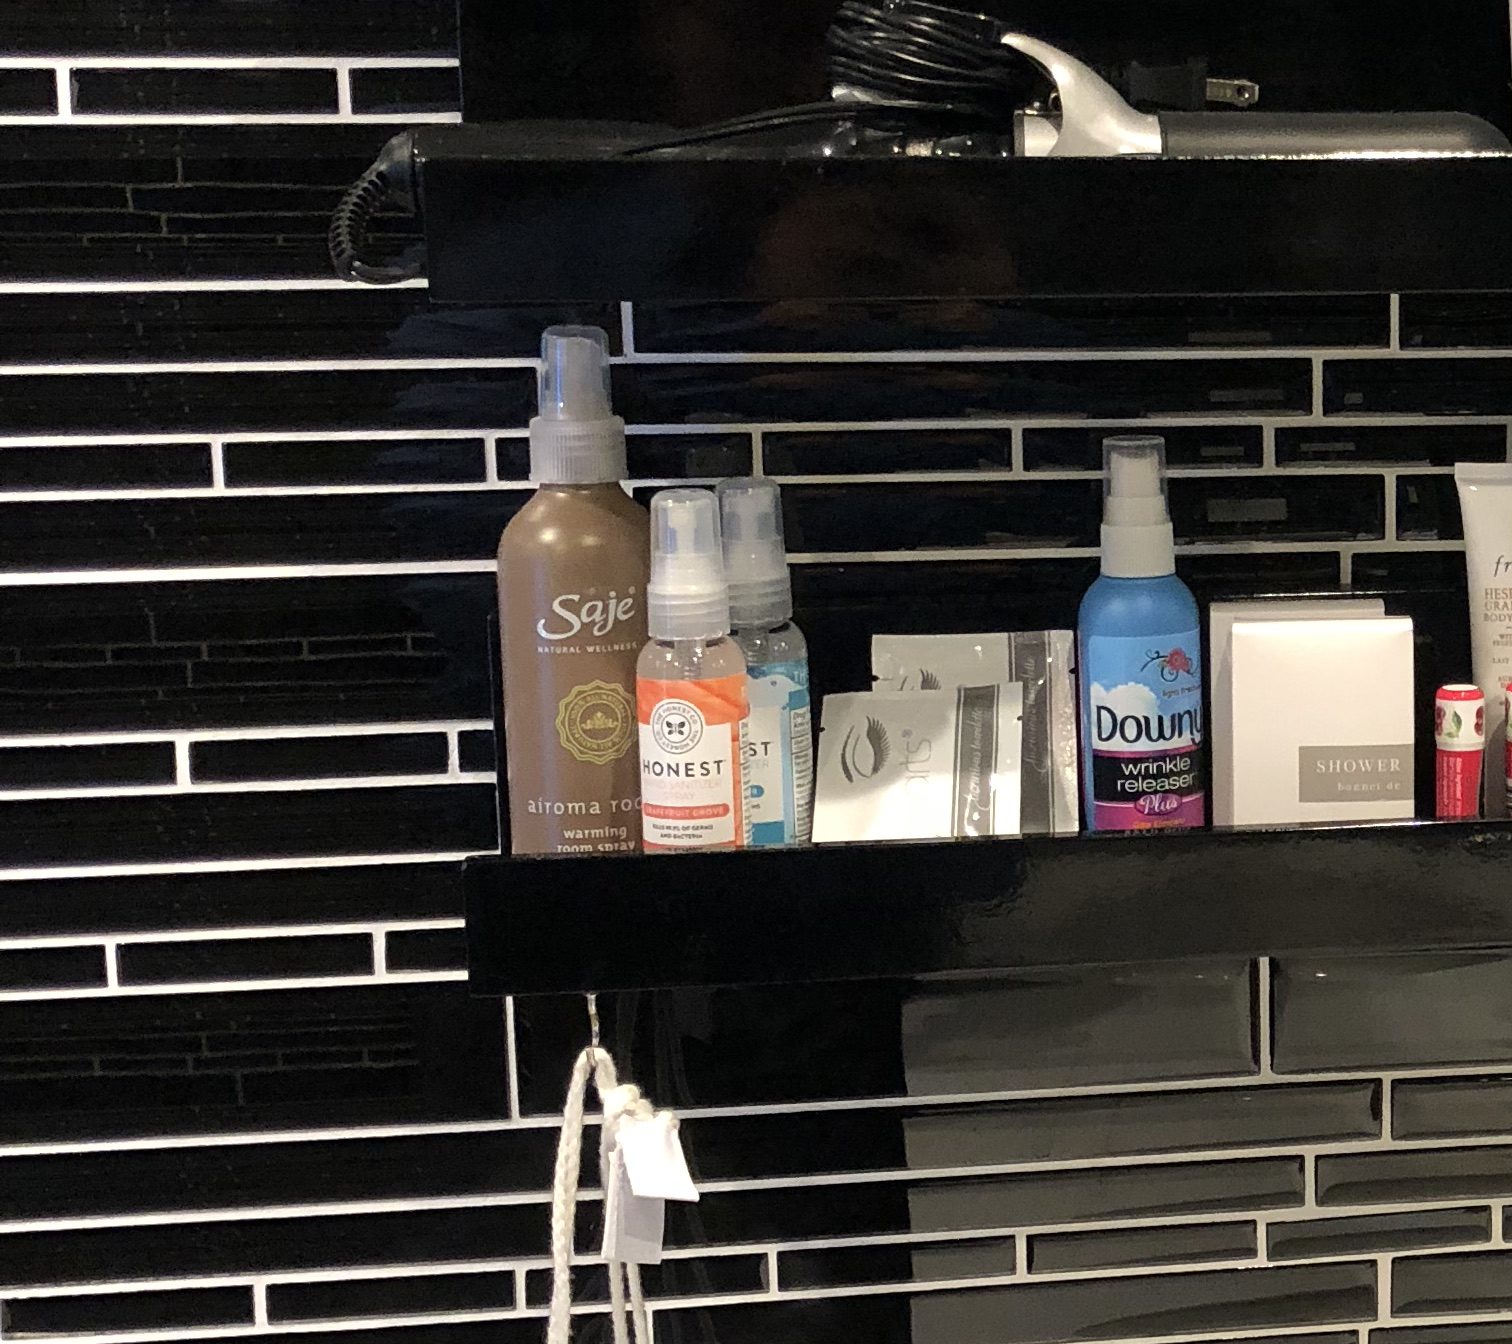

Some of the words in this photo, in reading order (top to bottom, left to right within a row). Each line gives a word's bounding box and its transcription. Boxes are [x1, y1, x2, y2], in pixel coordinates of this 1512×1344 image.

[537, 645, 582, 654] NATURAL
[586, 642, 638, 653] WELLNESS
[1096, 705, 1203, 746] Downy
[643, 759, 724, 778] HONEST
[1121, 757, 1191, 776] wrinkle
[1316, 757, 1401, 774] SHOWER
[1117, 772, 1195, 793] releaser
[527, 797, 601, 816] airoma
[1140, 794, 1178, 815] Plus
[563, 825, 627, 841] warming
